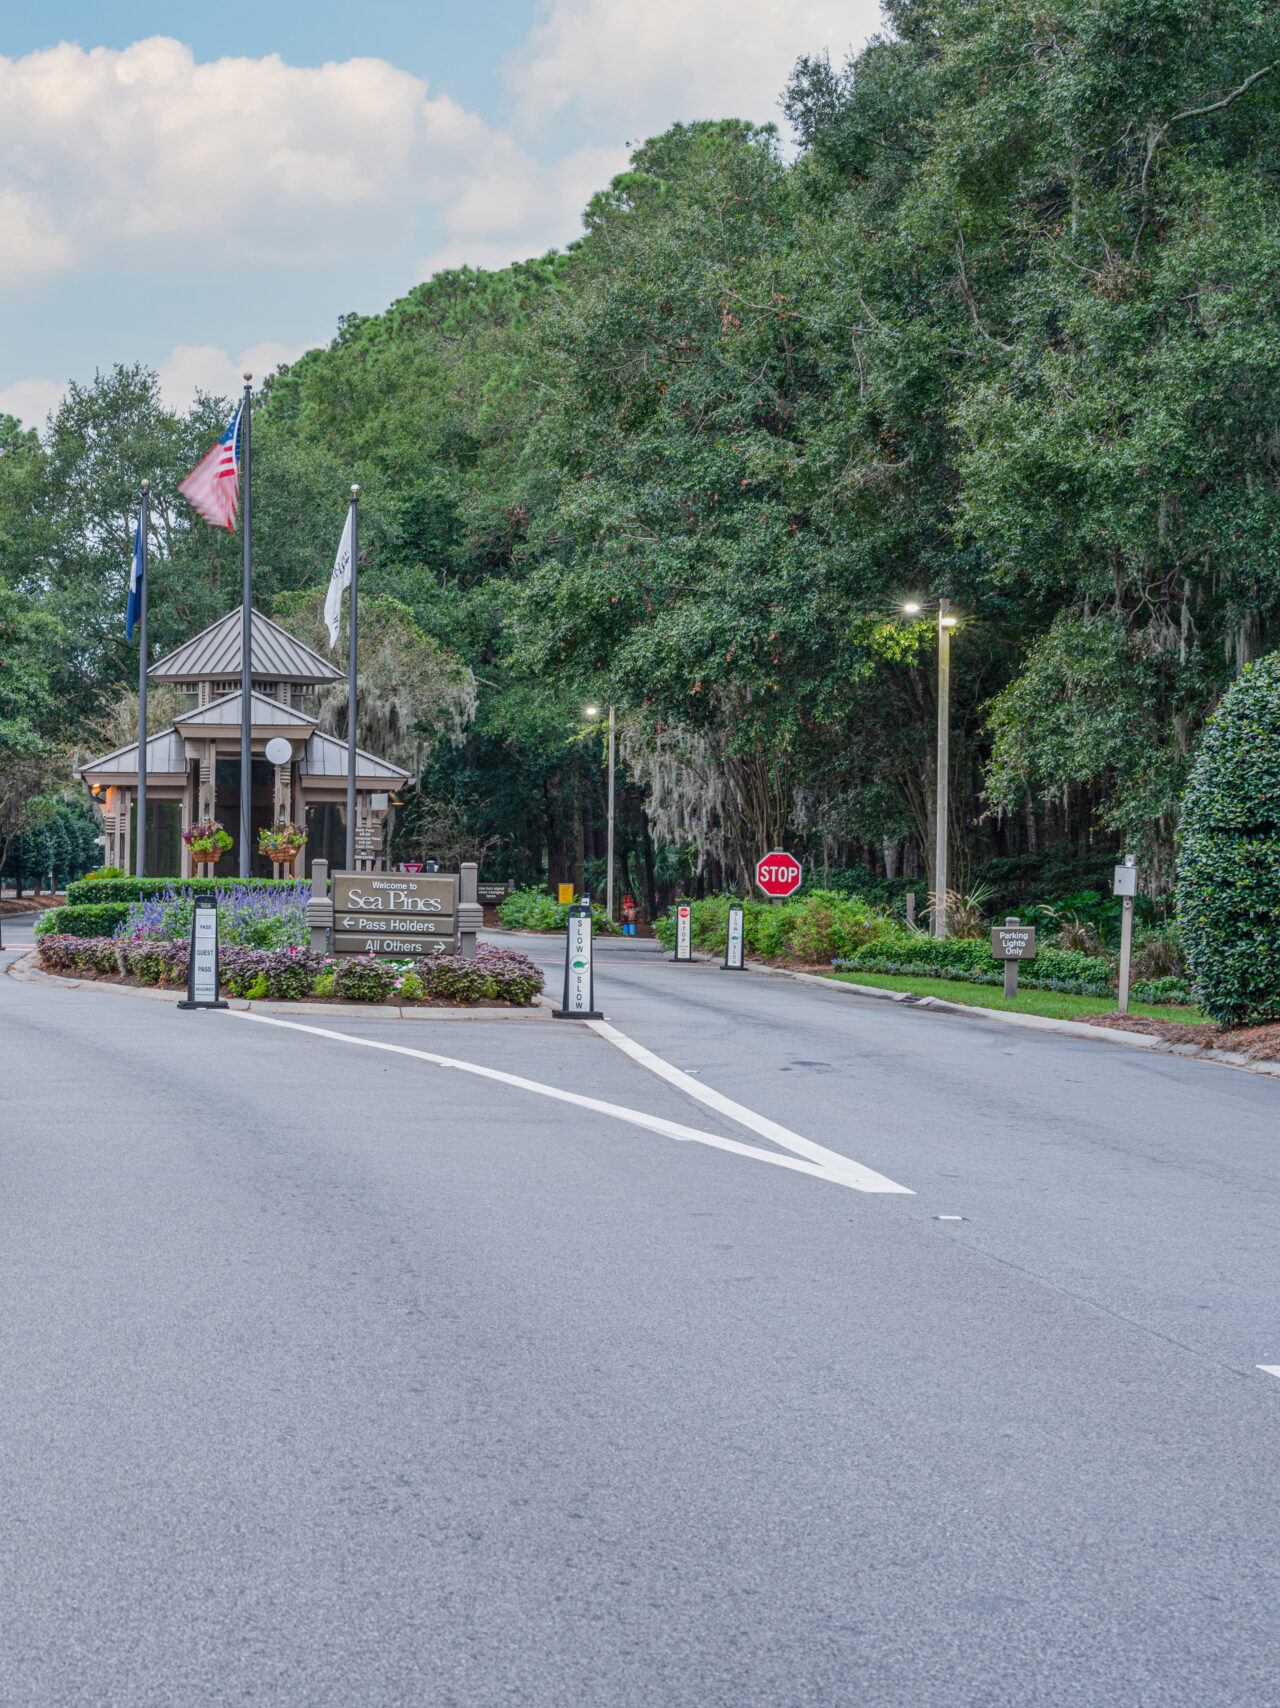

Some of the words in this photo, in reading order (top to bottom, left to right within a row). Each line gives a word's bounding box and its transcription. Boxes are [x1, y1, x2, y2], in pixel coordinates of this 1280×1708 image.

[760, 866, 798, 882] STOP
[372, 881, 407, 890] Welcome
[348, 889, 384, 909] Sea
[387, 891, 441, 911] Pines
[359, 919, 386, 930] Pass
[390, 920, 435, 931] Holders
[1000, 932, 1028, 940] Parking
[365, 940, 380, 951] All
[384, 940, 422, 952] Others
[1006, 947, 1023, 956] Only
